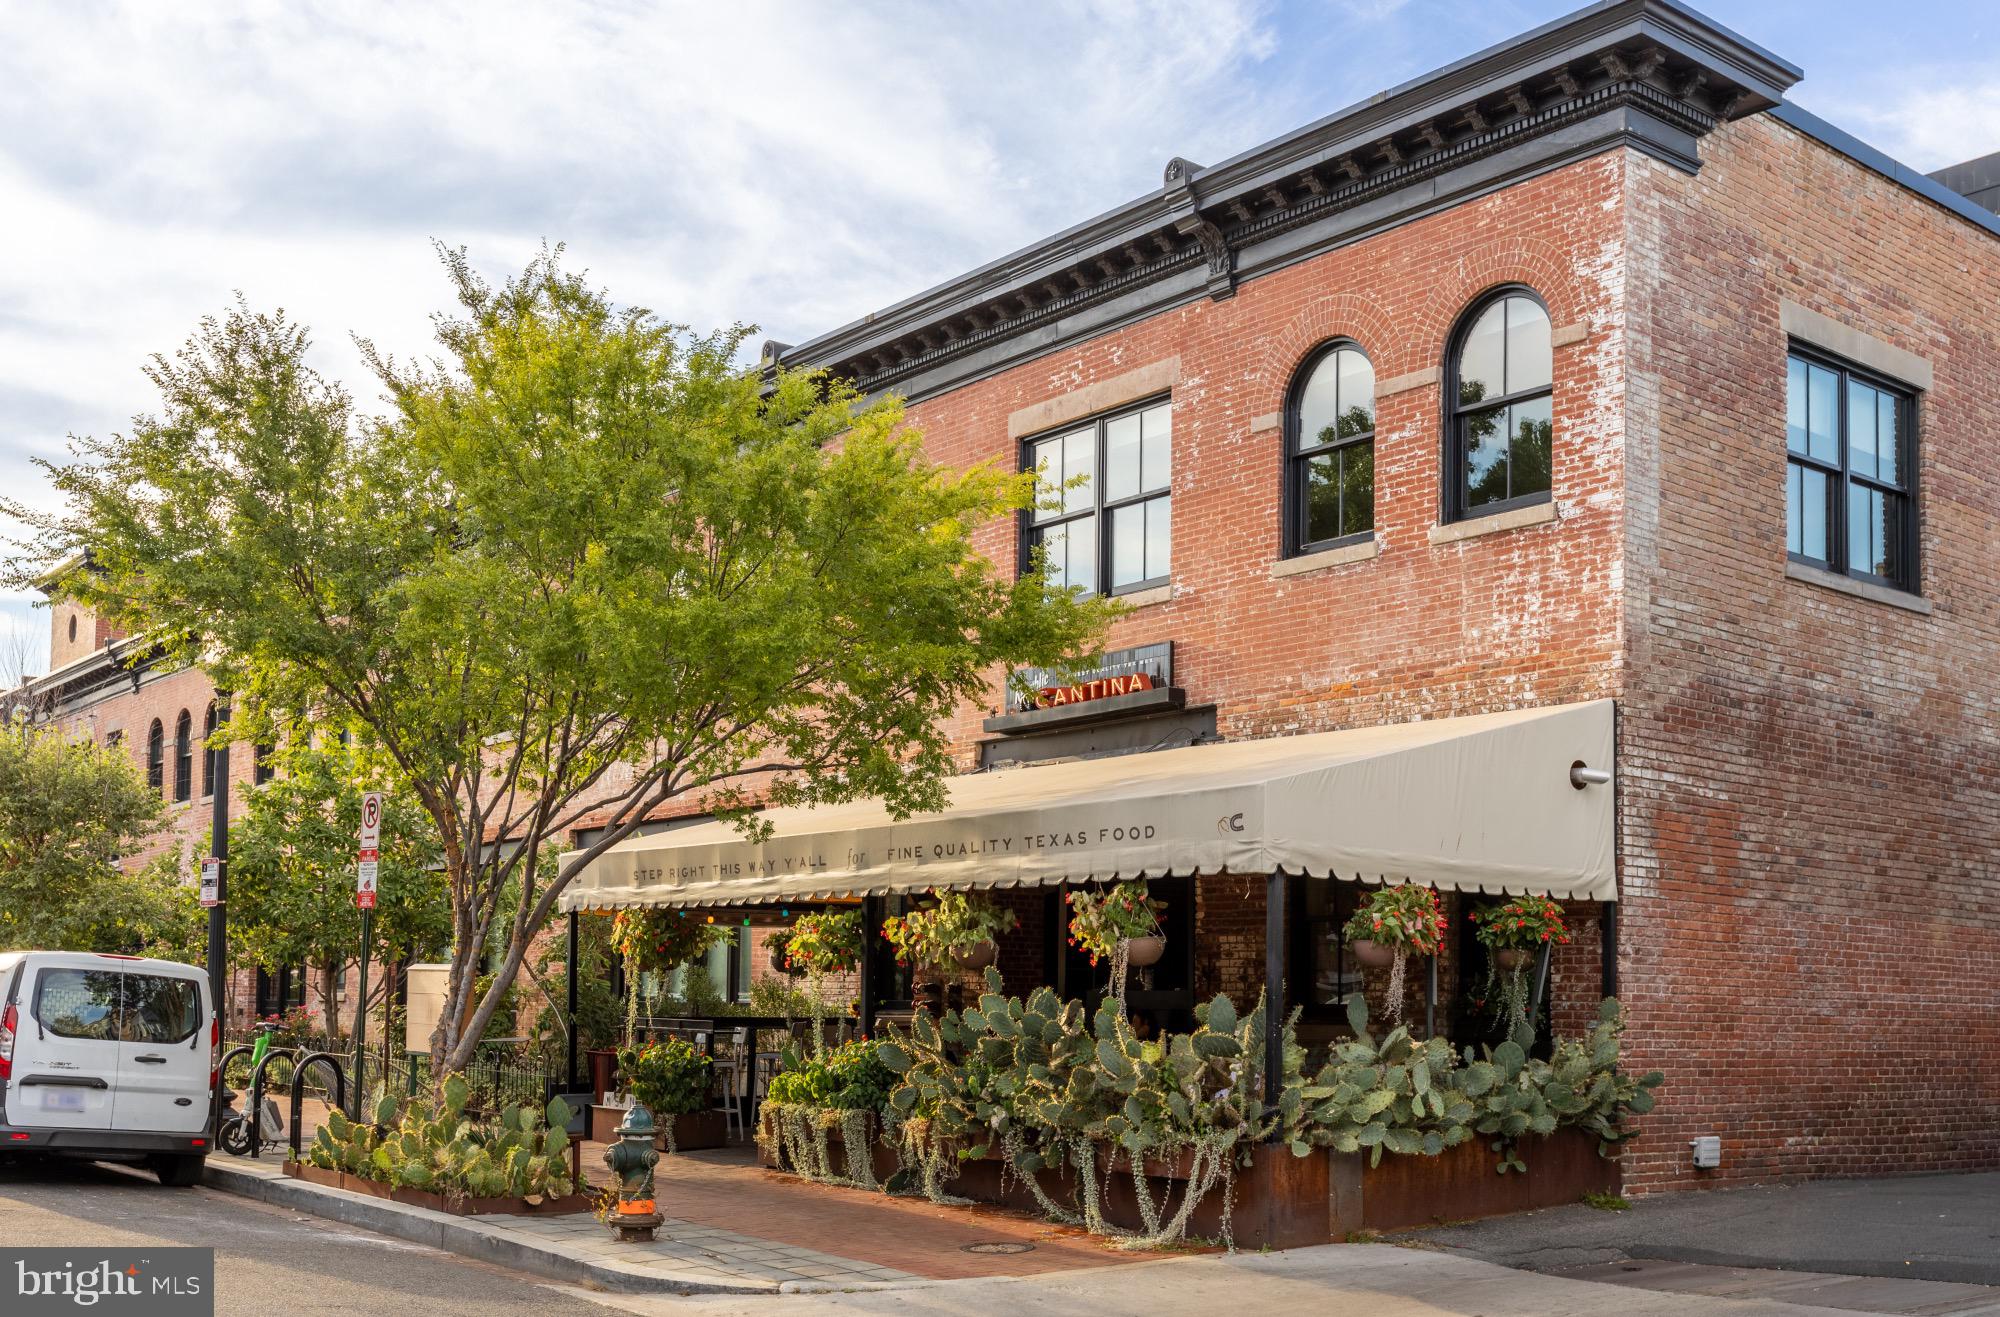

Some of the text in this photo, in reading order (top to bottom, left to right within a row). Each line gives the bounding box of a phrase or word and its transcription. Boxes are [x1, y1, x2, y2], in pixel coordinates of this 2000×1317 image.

[1035, 673, 1143, 709] CANTINA
[633, 825, 1156, 880] STEP RIGHT THIS WAY Y'ALL for FINE QUALITY TEXAS FOOD
